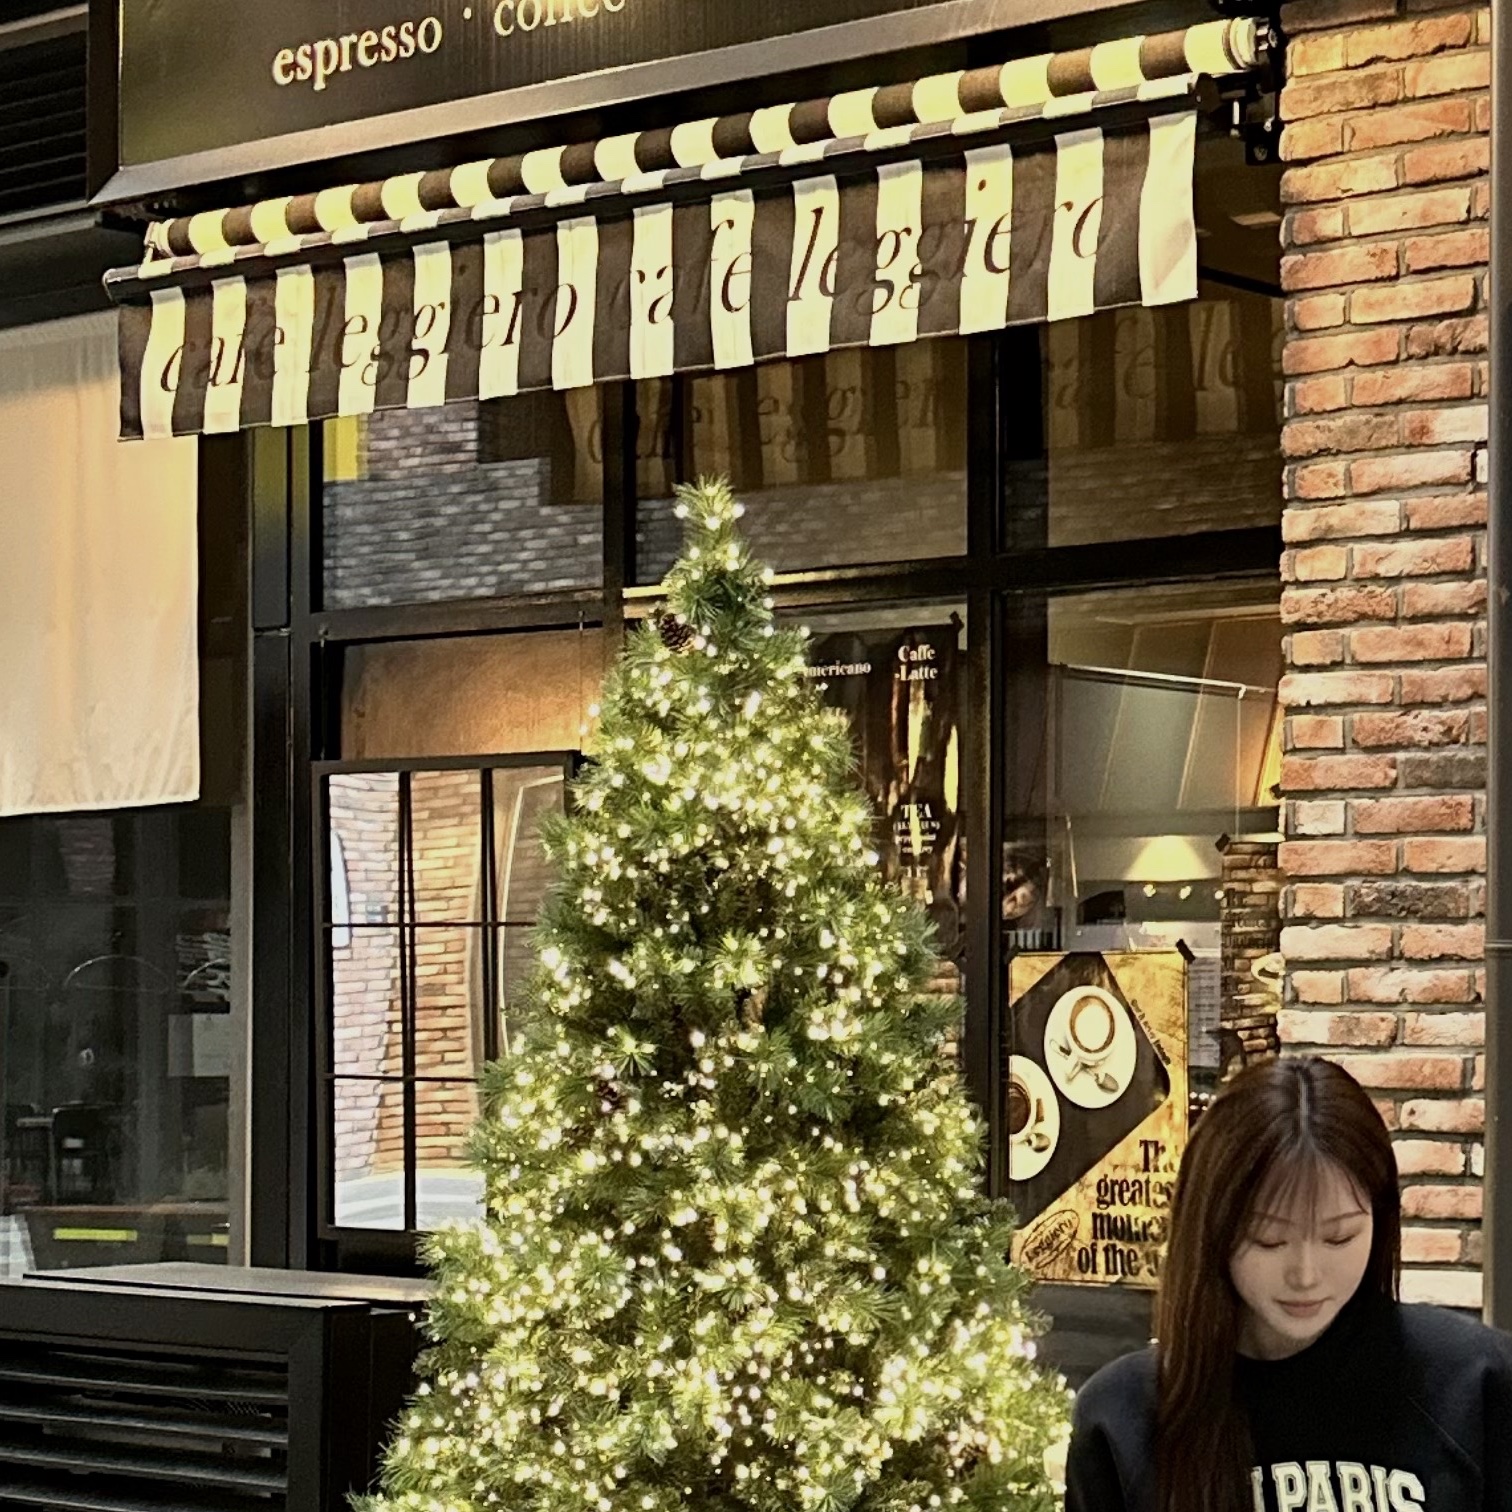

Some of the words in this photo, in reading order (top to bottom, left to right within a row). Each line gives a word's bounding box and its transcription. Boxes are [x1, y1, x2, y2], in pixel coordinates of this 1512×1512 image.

[272, 16, 442, 90] espresso
[306, 264, 578, 387] leggiero
[802, 659, 871, 678] mericano
[900, 665, 938, 681] Latte
[1096, 1174, 1173, 1210] greates
[1077, 1242, 1098, 1275] of
[1103, 1243, 1141, 1277] the
